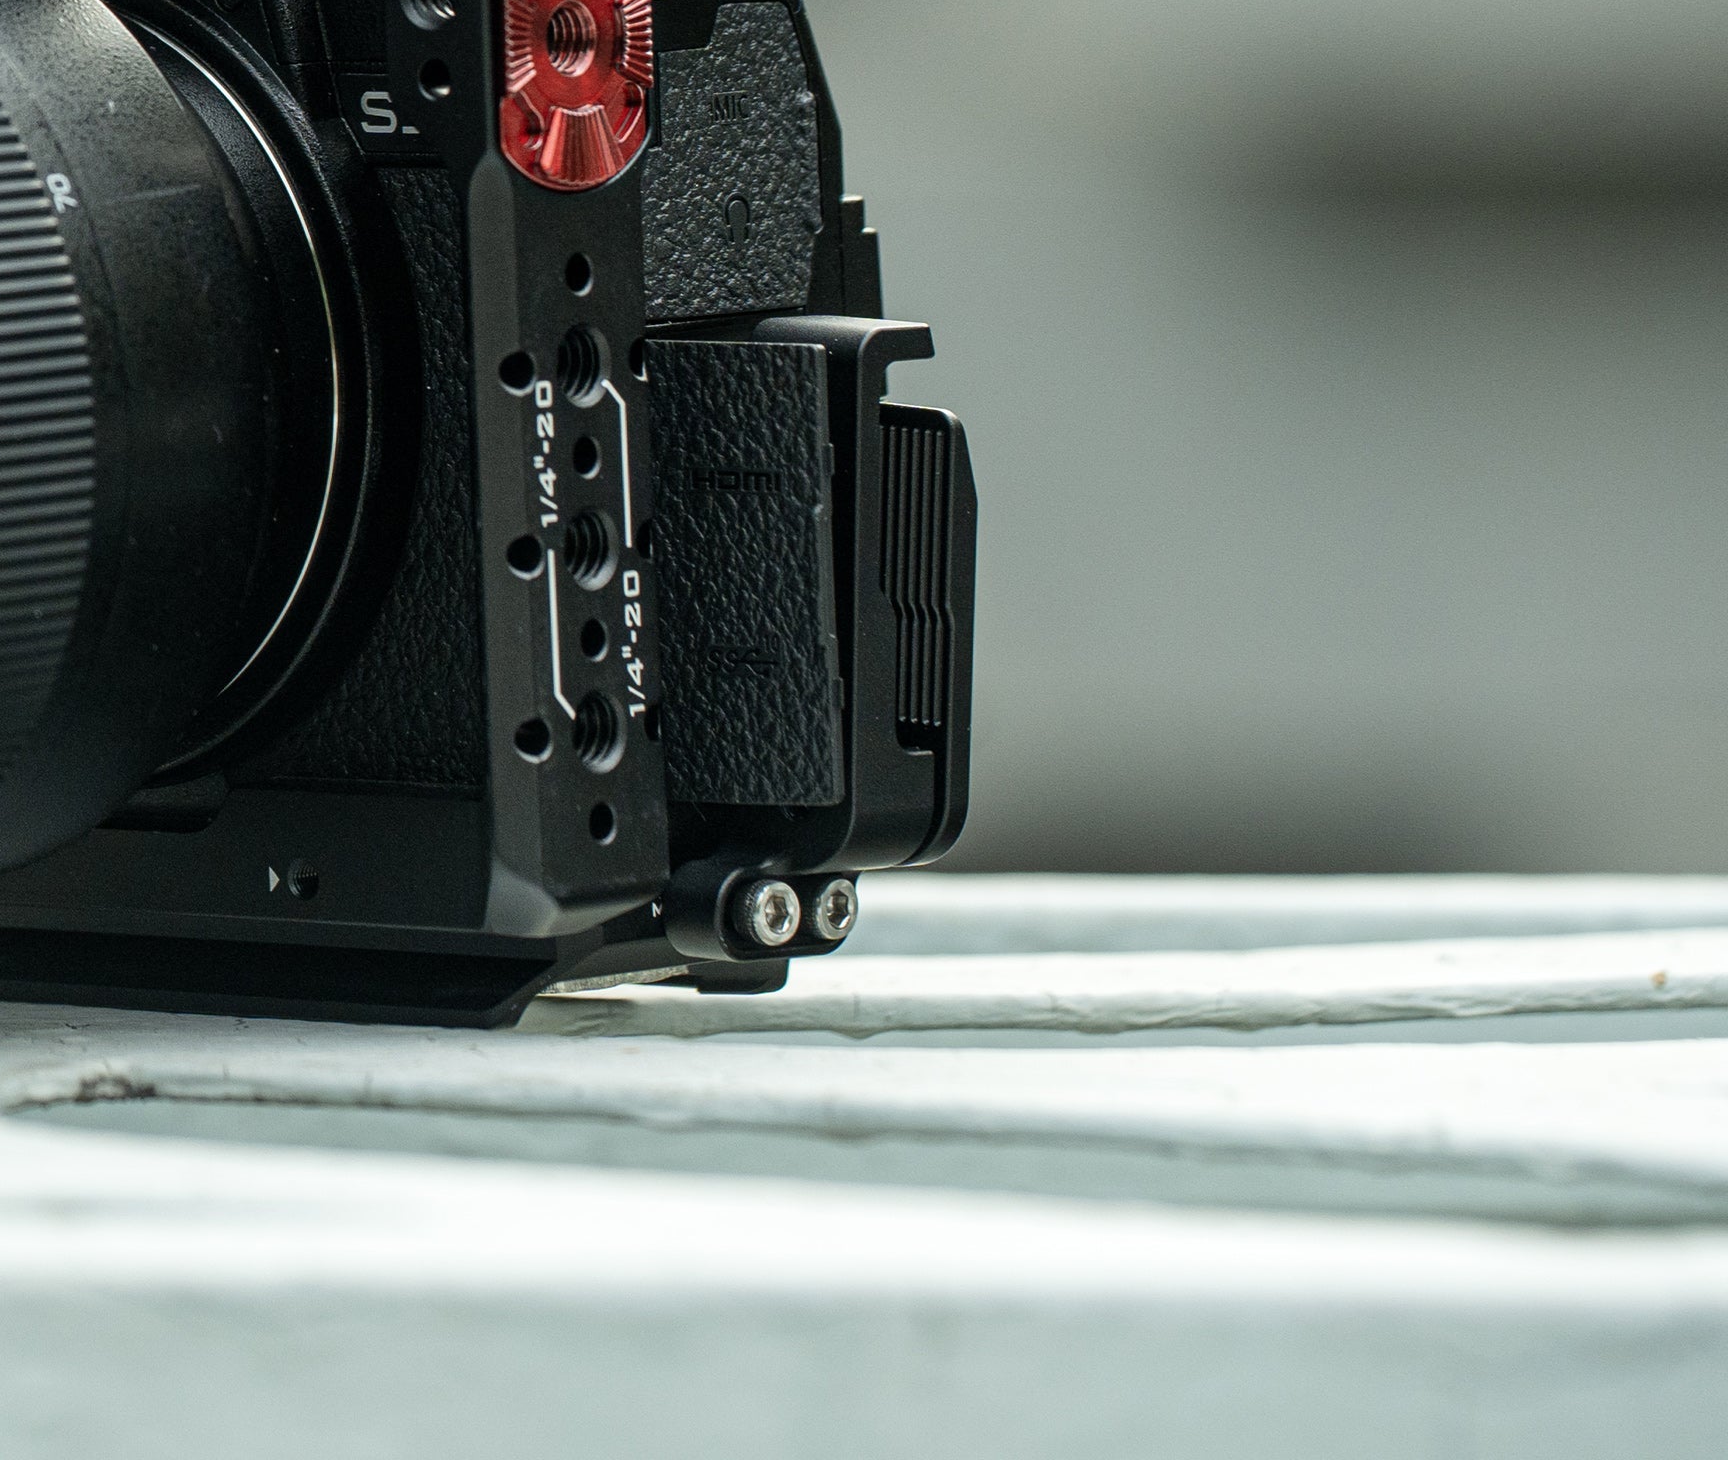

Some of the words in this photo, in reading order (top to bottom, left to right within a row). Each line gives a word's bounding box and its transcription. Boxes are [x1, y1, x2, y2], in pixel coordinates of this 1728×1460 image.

[360, 91, 420, 134] S
[534, 380, 559, 528] 1/4"-20
[692, 470, 781, 490] HDMI
[621, 570, 646, 718] 1/4"-20
